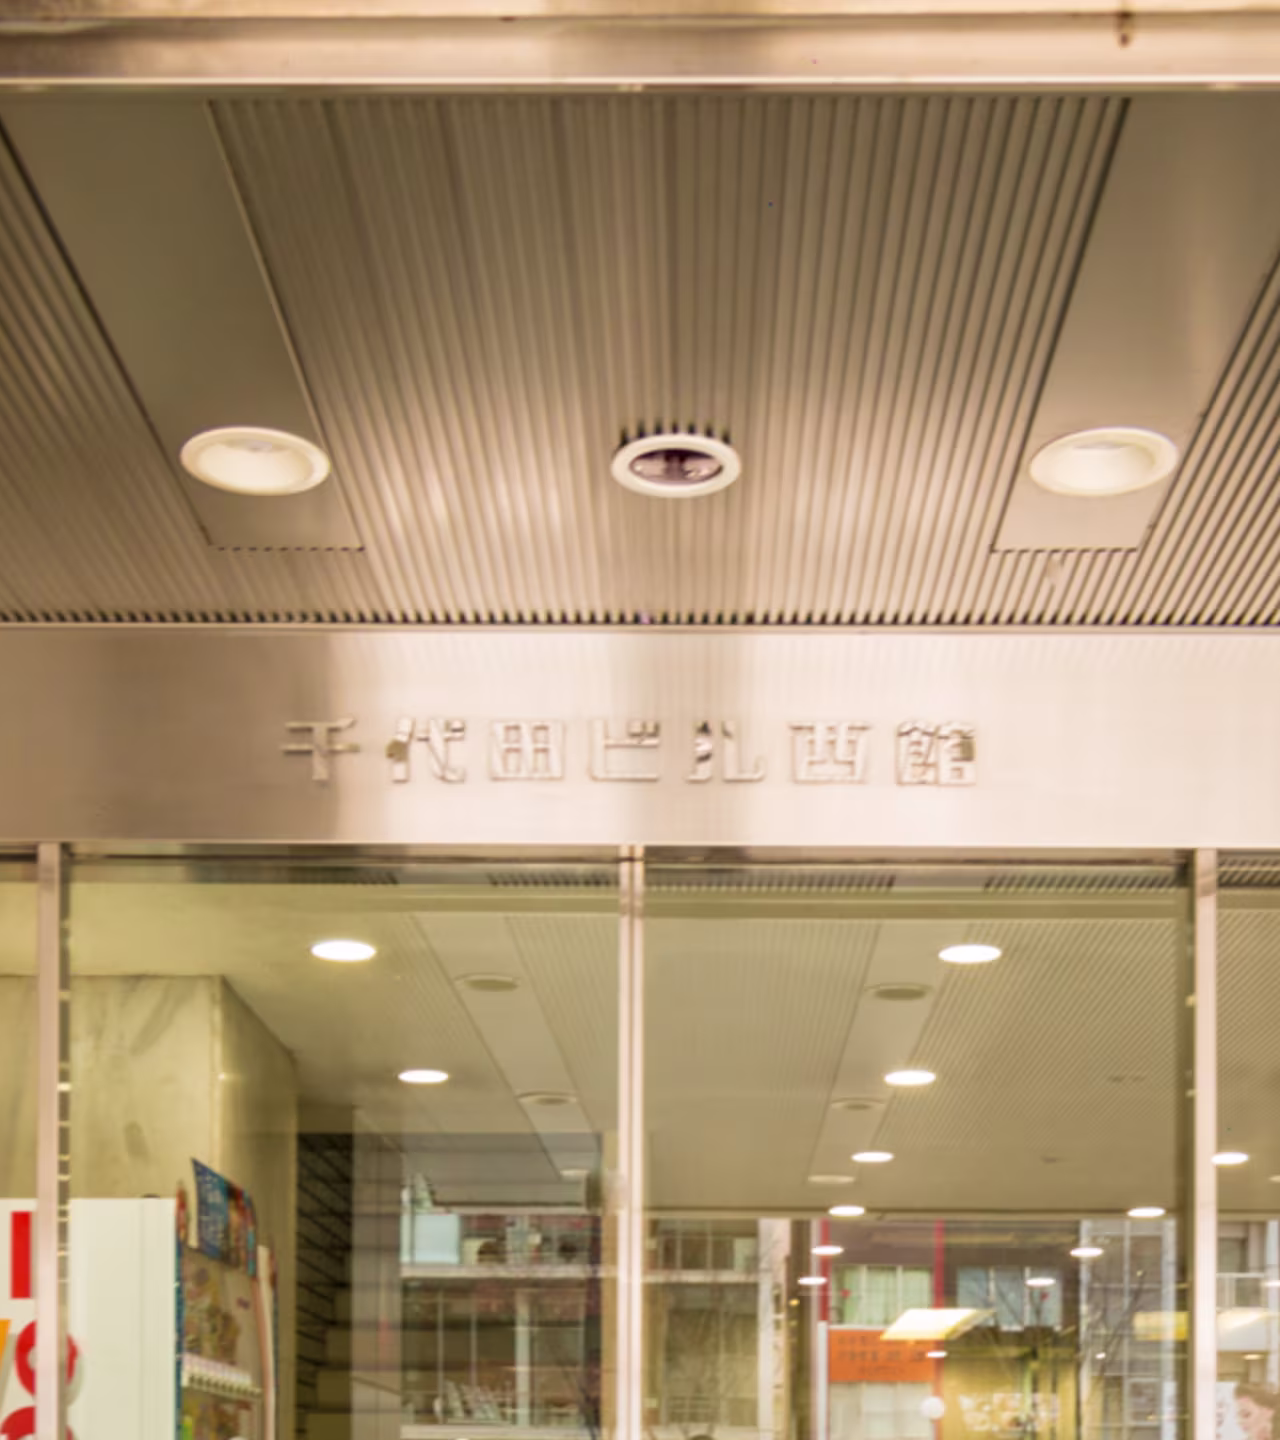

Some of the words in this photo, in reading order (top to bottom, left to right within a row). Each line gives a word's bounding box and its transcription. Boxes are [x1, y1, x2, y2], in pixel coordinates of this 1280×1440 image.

[281, 718, 977, 787] 千代田ビル西館
